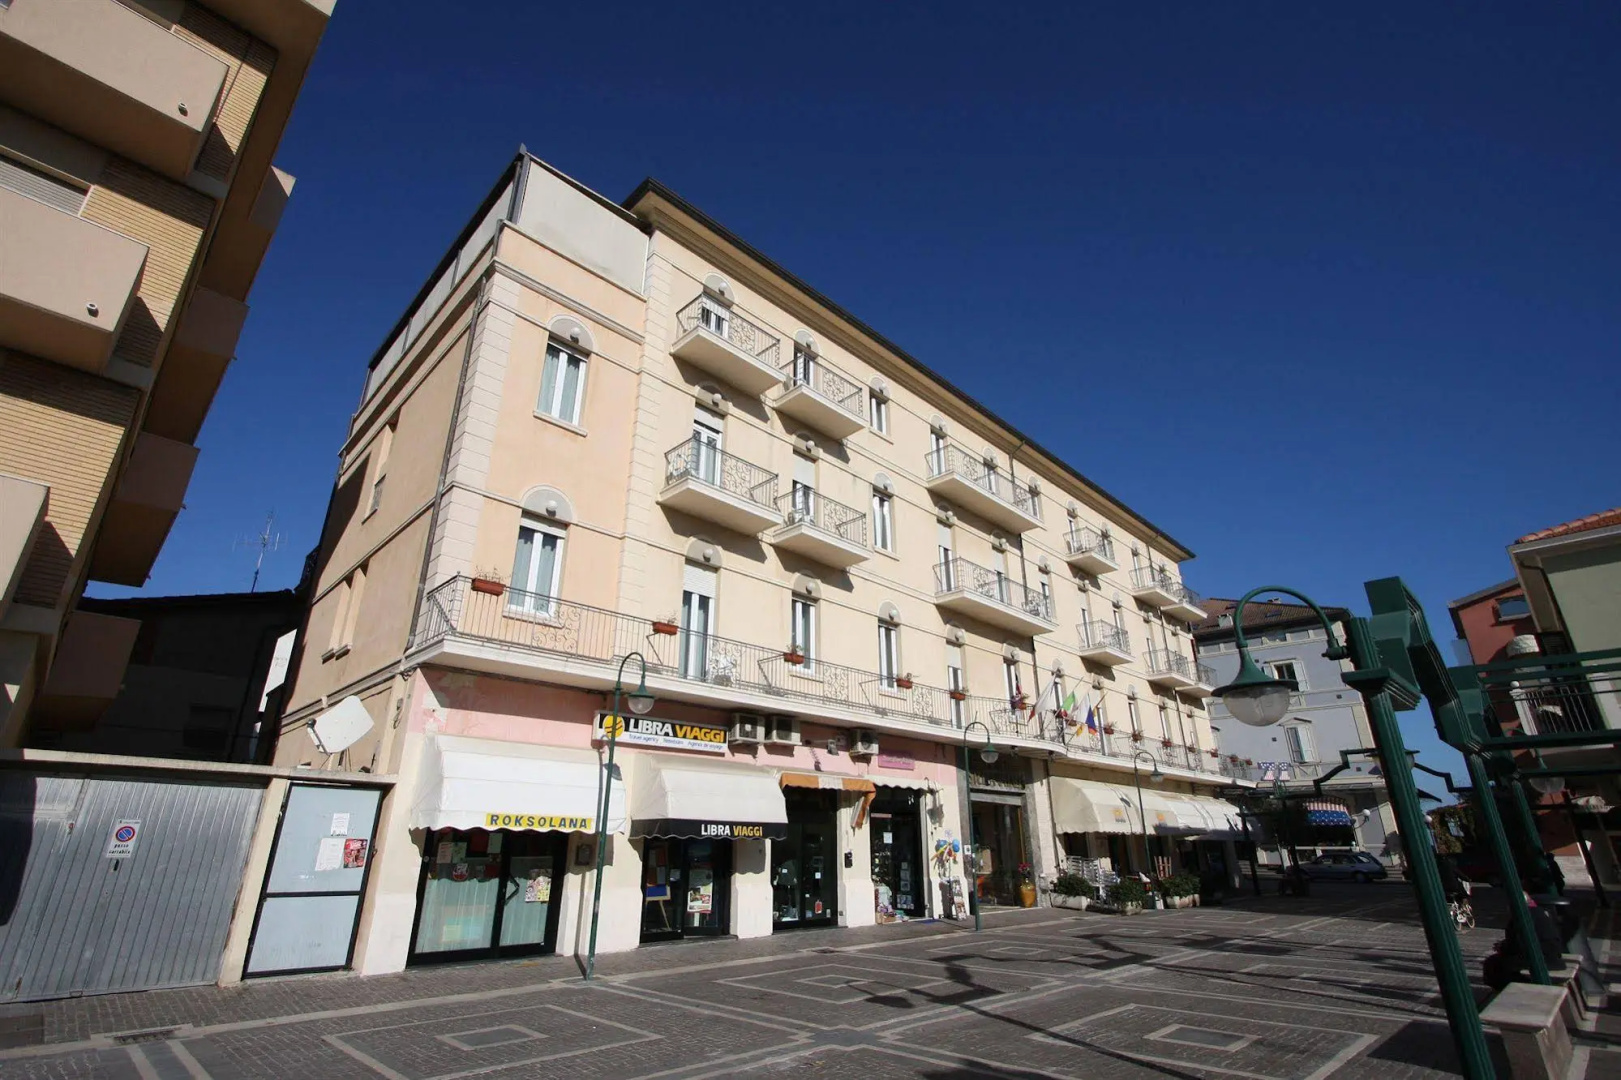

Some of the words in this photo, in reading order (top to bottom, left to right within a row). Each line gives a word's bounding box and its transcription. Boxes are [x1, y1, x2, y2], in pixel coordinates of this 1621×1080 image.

[629, 718, 673, 736] LIBRA
[675, 725, 724, 742] VIAGGI
[490, 814, 588, 829] ROKSOLANA
[701, 824, 731, 836] LIBRA
[733, 825, 763, 837] VIAGGI
